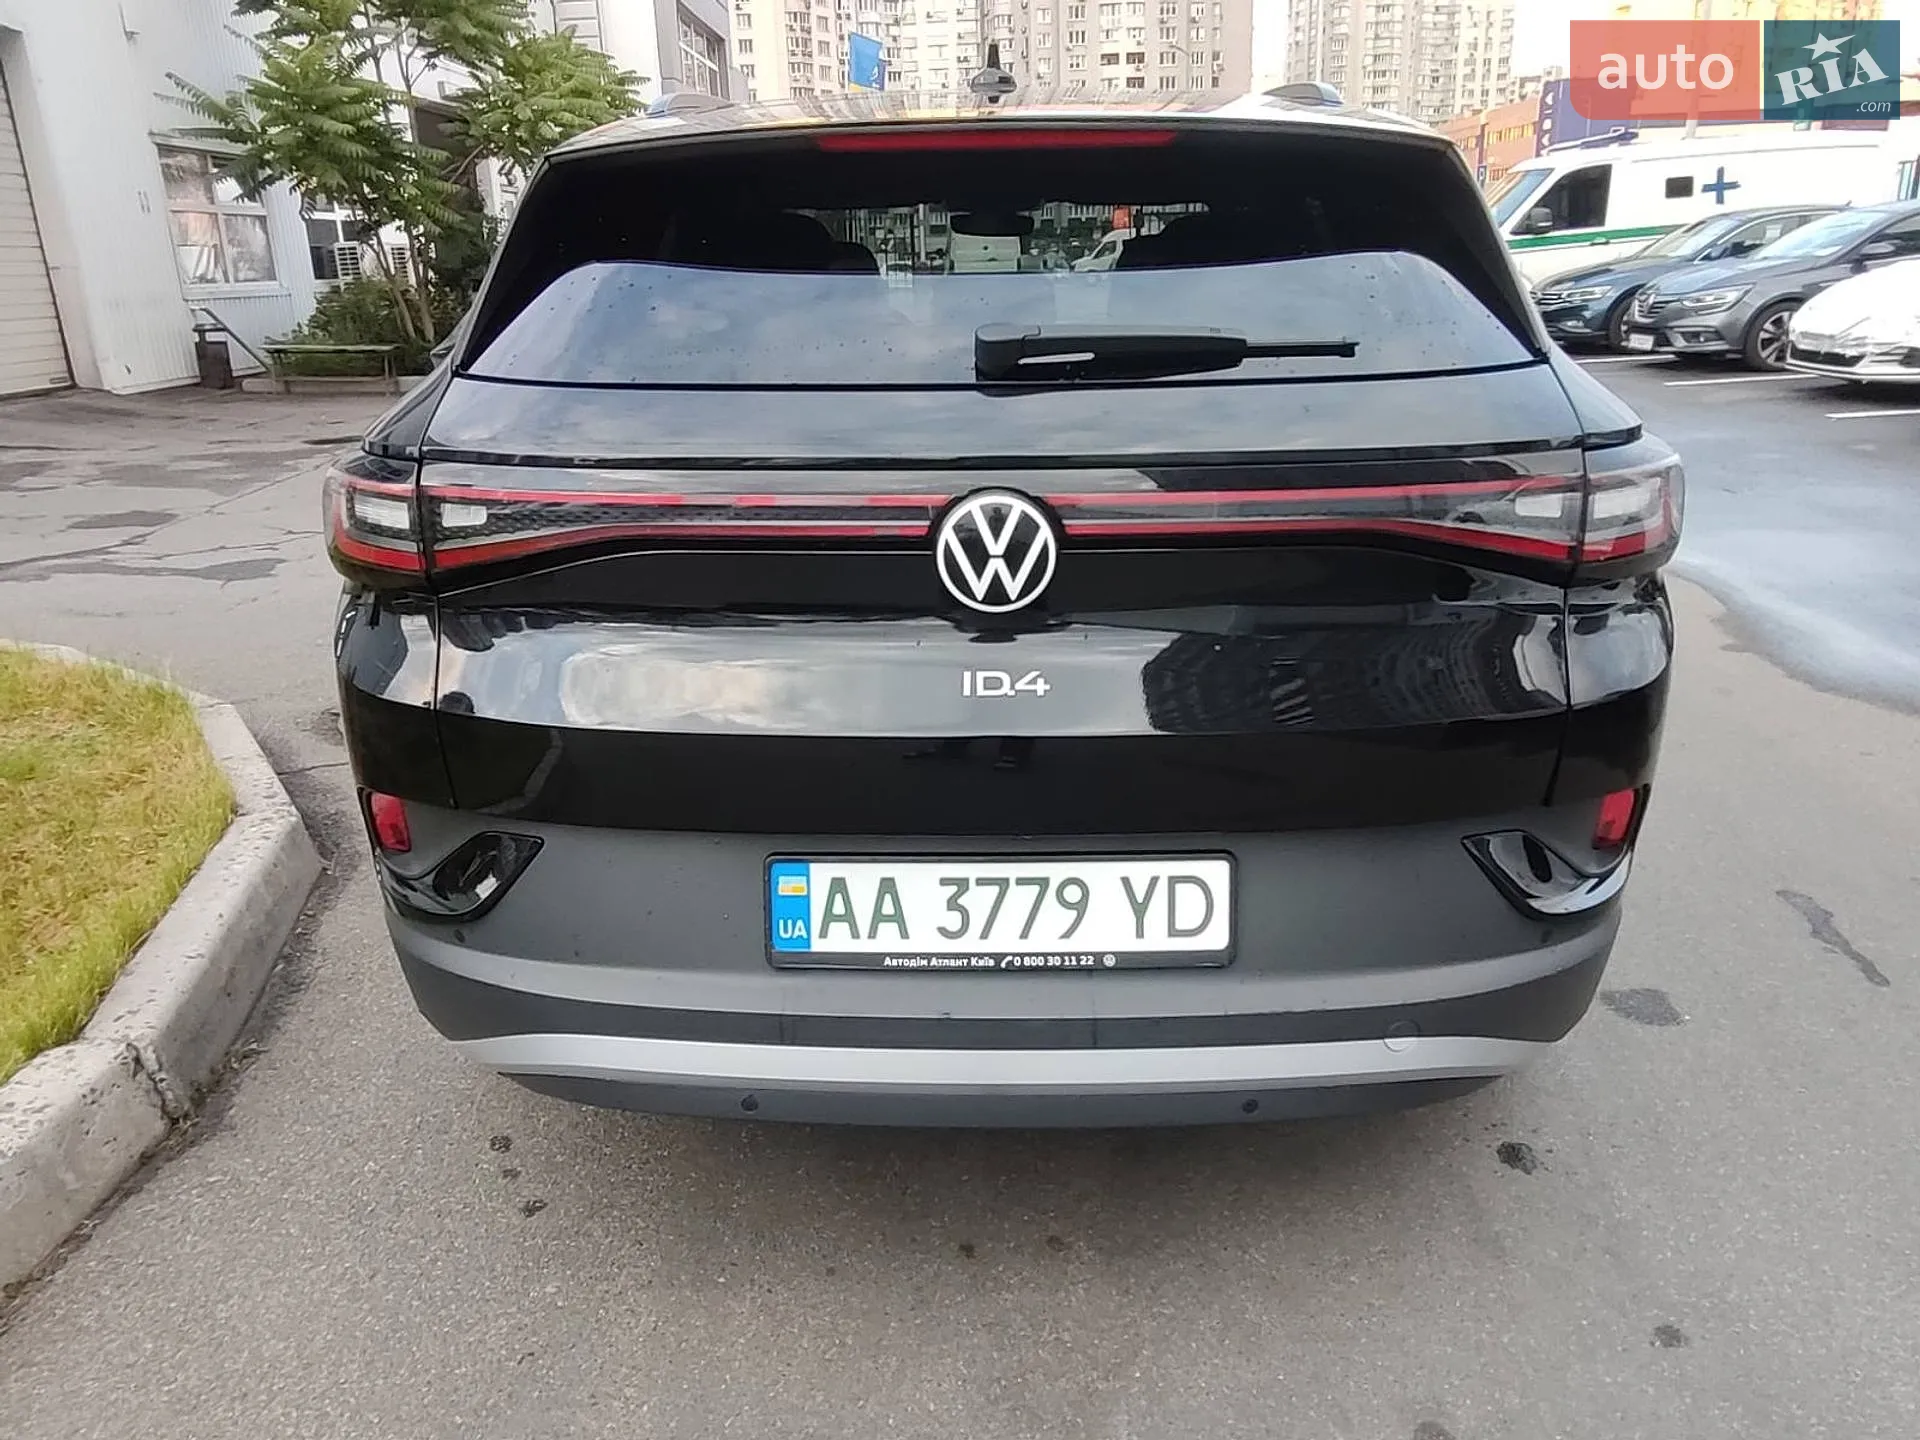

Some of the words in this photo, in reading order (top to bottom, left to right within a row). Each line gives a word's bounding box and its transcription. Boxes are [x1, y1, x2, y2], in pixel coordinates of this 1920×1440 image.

[962, 670, 1050, 697] ID.4
[818, 876, 910, 940] AA
[936, 876, 1090, 940] 3779
[1120, 875, 1215, 939] YD
[778, 919, 808, 939] UA
[1013, 956, 1020, 966] 0
[1023, 956, 1043, 966] 800
[1046, 955, 1061, 966] 30
[1063, 956, 1077, 965] 11
[1079, 956, 1094, 965] 22
